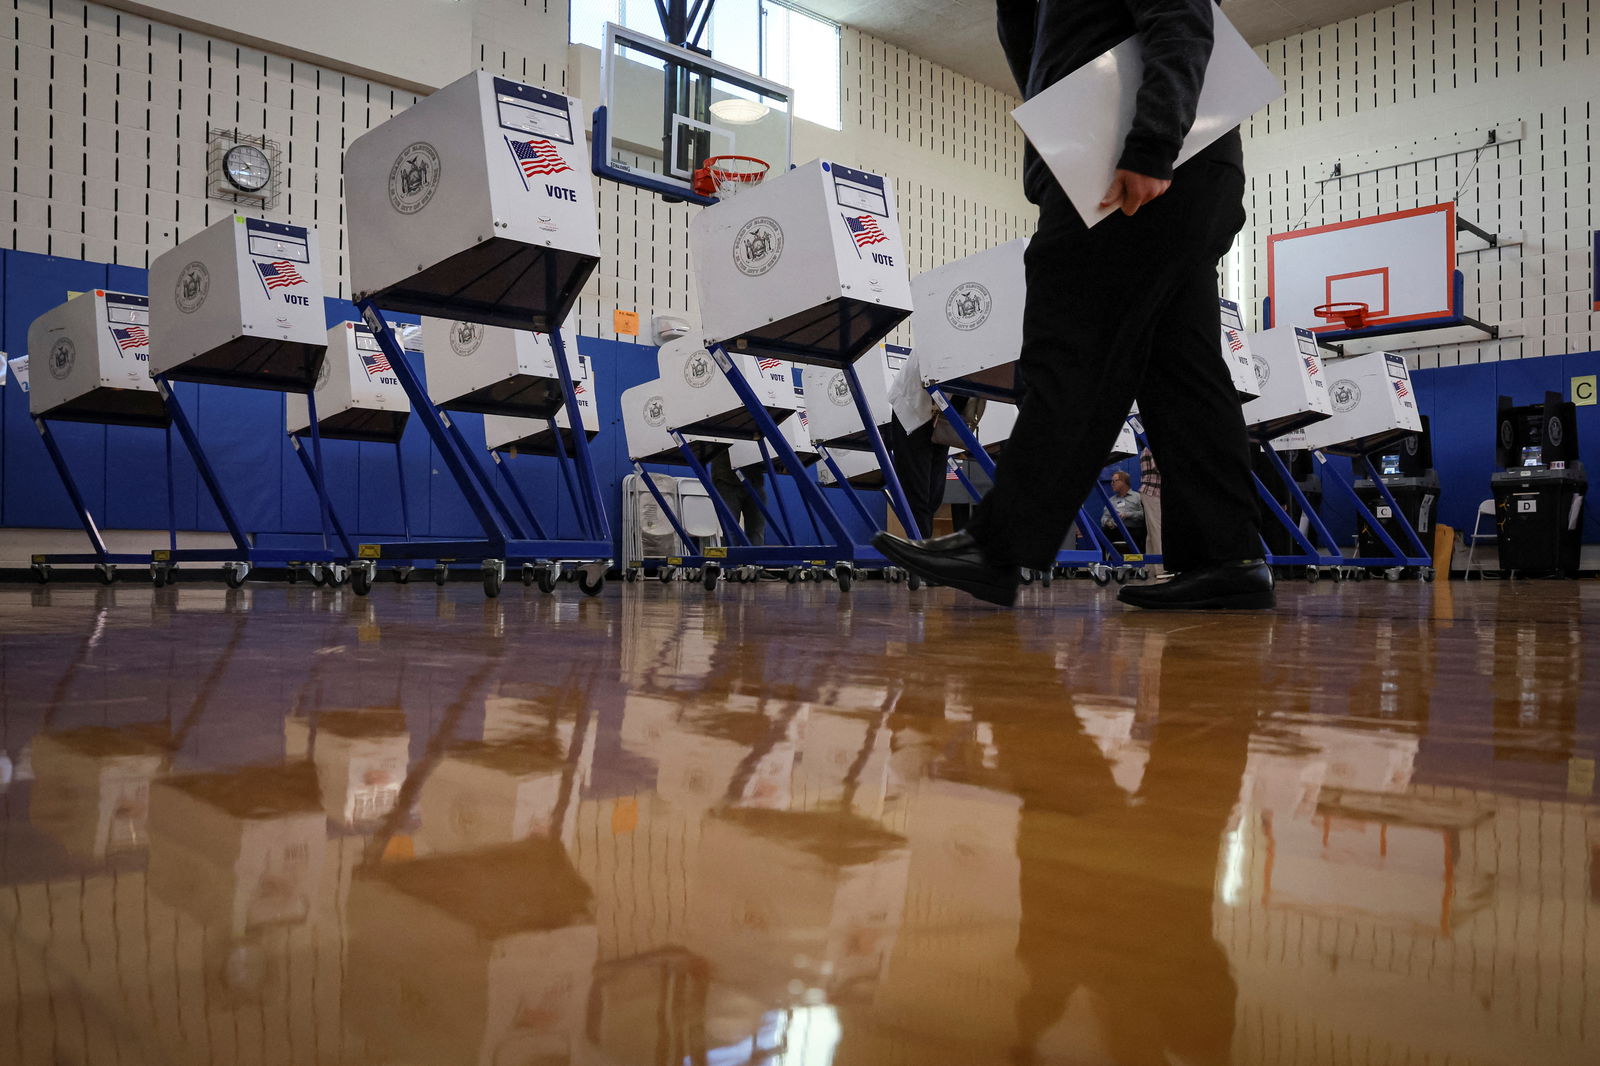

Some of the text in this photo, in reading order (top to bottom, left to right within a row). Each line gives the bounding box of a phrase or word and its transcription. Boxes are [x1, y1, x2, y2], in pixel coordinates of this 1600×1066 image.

[545, 184, 577, 202] VOTE
[872, 252, 894, 267] VOTE
[284, 294, 310, 306] VOTE
[134, 353, 150, 362] VOT
[380, 377, 398, 386] VOTE
[770, 373, 784, 382] VOTE
[1576, 382, 1592, 400] C
[1524, 502, 1530, 510] D
